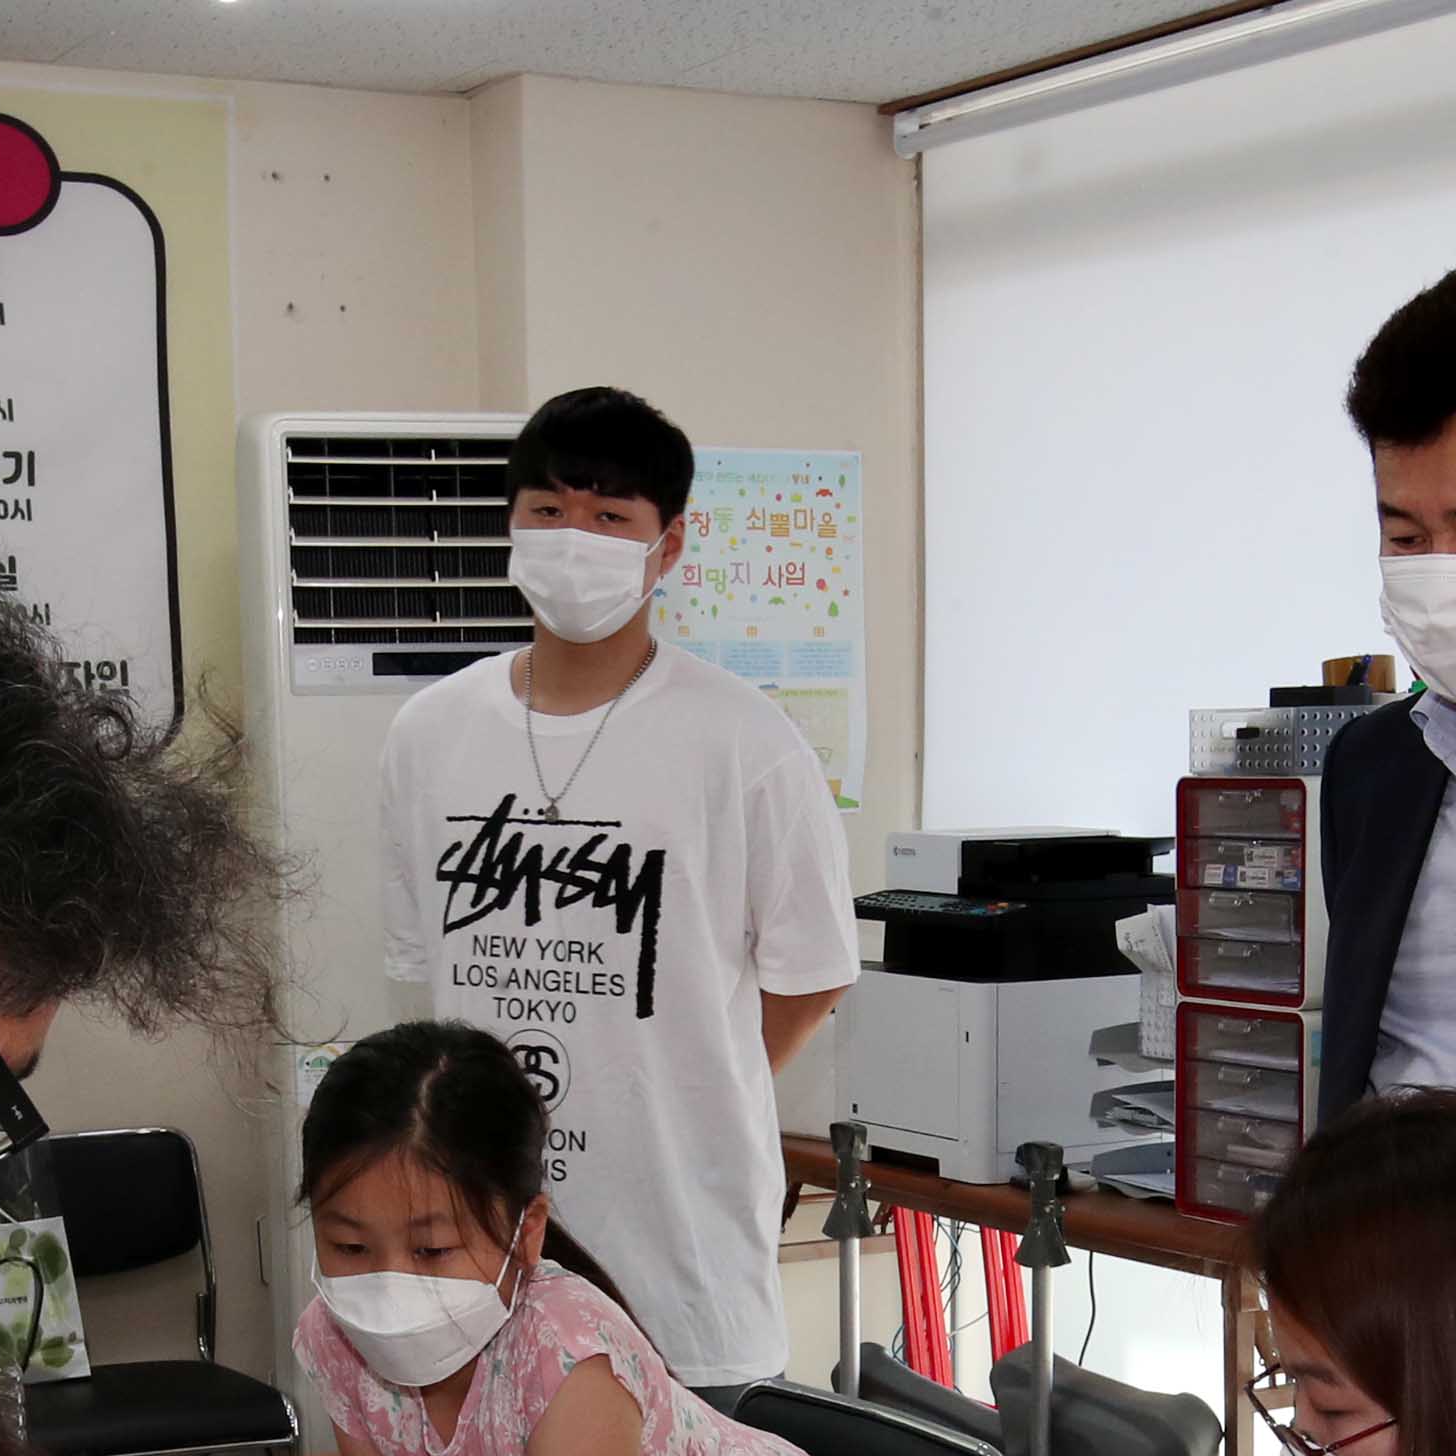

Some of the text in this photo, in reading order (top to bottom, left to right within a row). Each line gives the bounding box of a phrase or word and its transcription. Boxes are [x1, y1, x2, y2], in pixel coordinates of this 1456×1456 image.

[762, 561, 806, 589] 사업
[472, 934, 605, 965] NEW YORK
[453, 963, 626, 997] LOS ANGELES
[493, 996, 577, 1024] TOKYO
